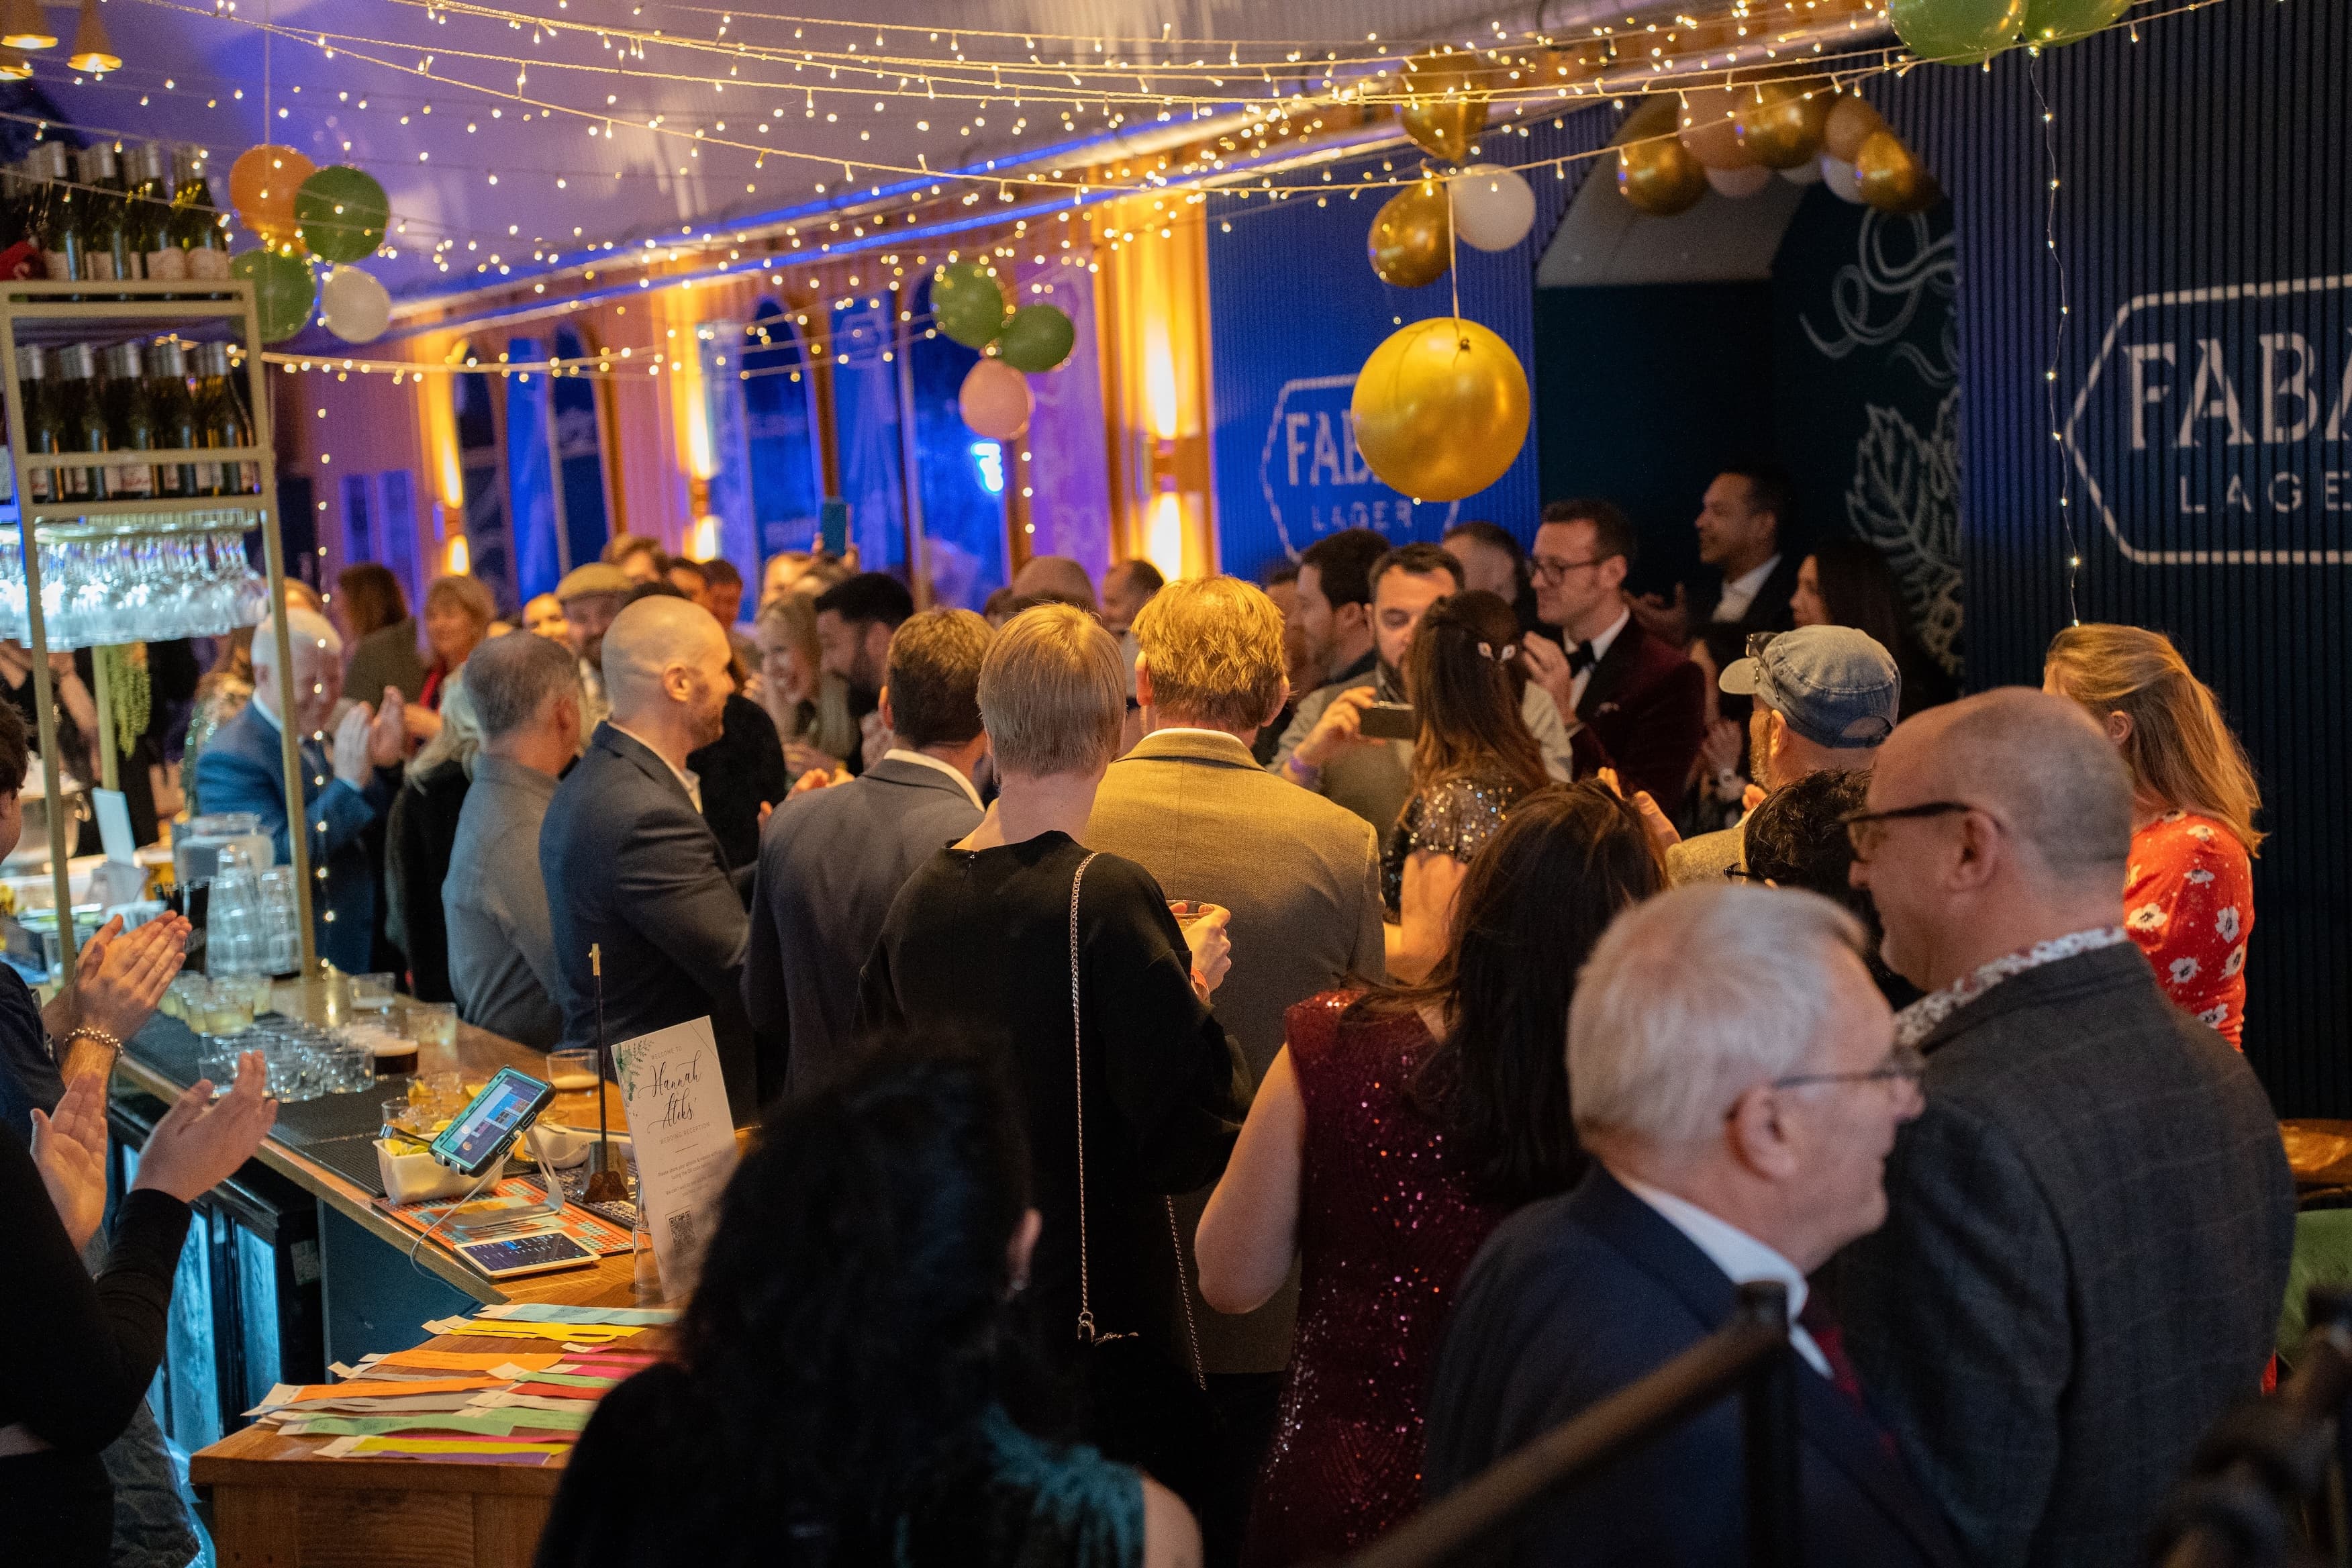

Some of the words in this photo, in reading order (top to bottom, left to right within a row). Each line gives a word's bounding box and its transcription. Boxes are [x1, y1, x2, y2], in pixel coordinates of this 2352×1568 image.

[1311, 499, 1412, 532] LAGER
[651, 1048, 675, 1060] WELCOME
[638, 1050, 702, 1099] Hannah
[660, 1132, 682, 1144] WEDDING
[683, 1122, 710, 1135] RECEPTION
